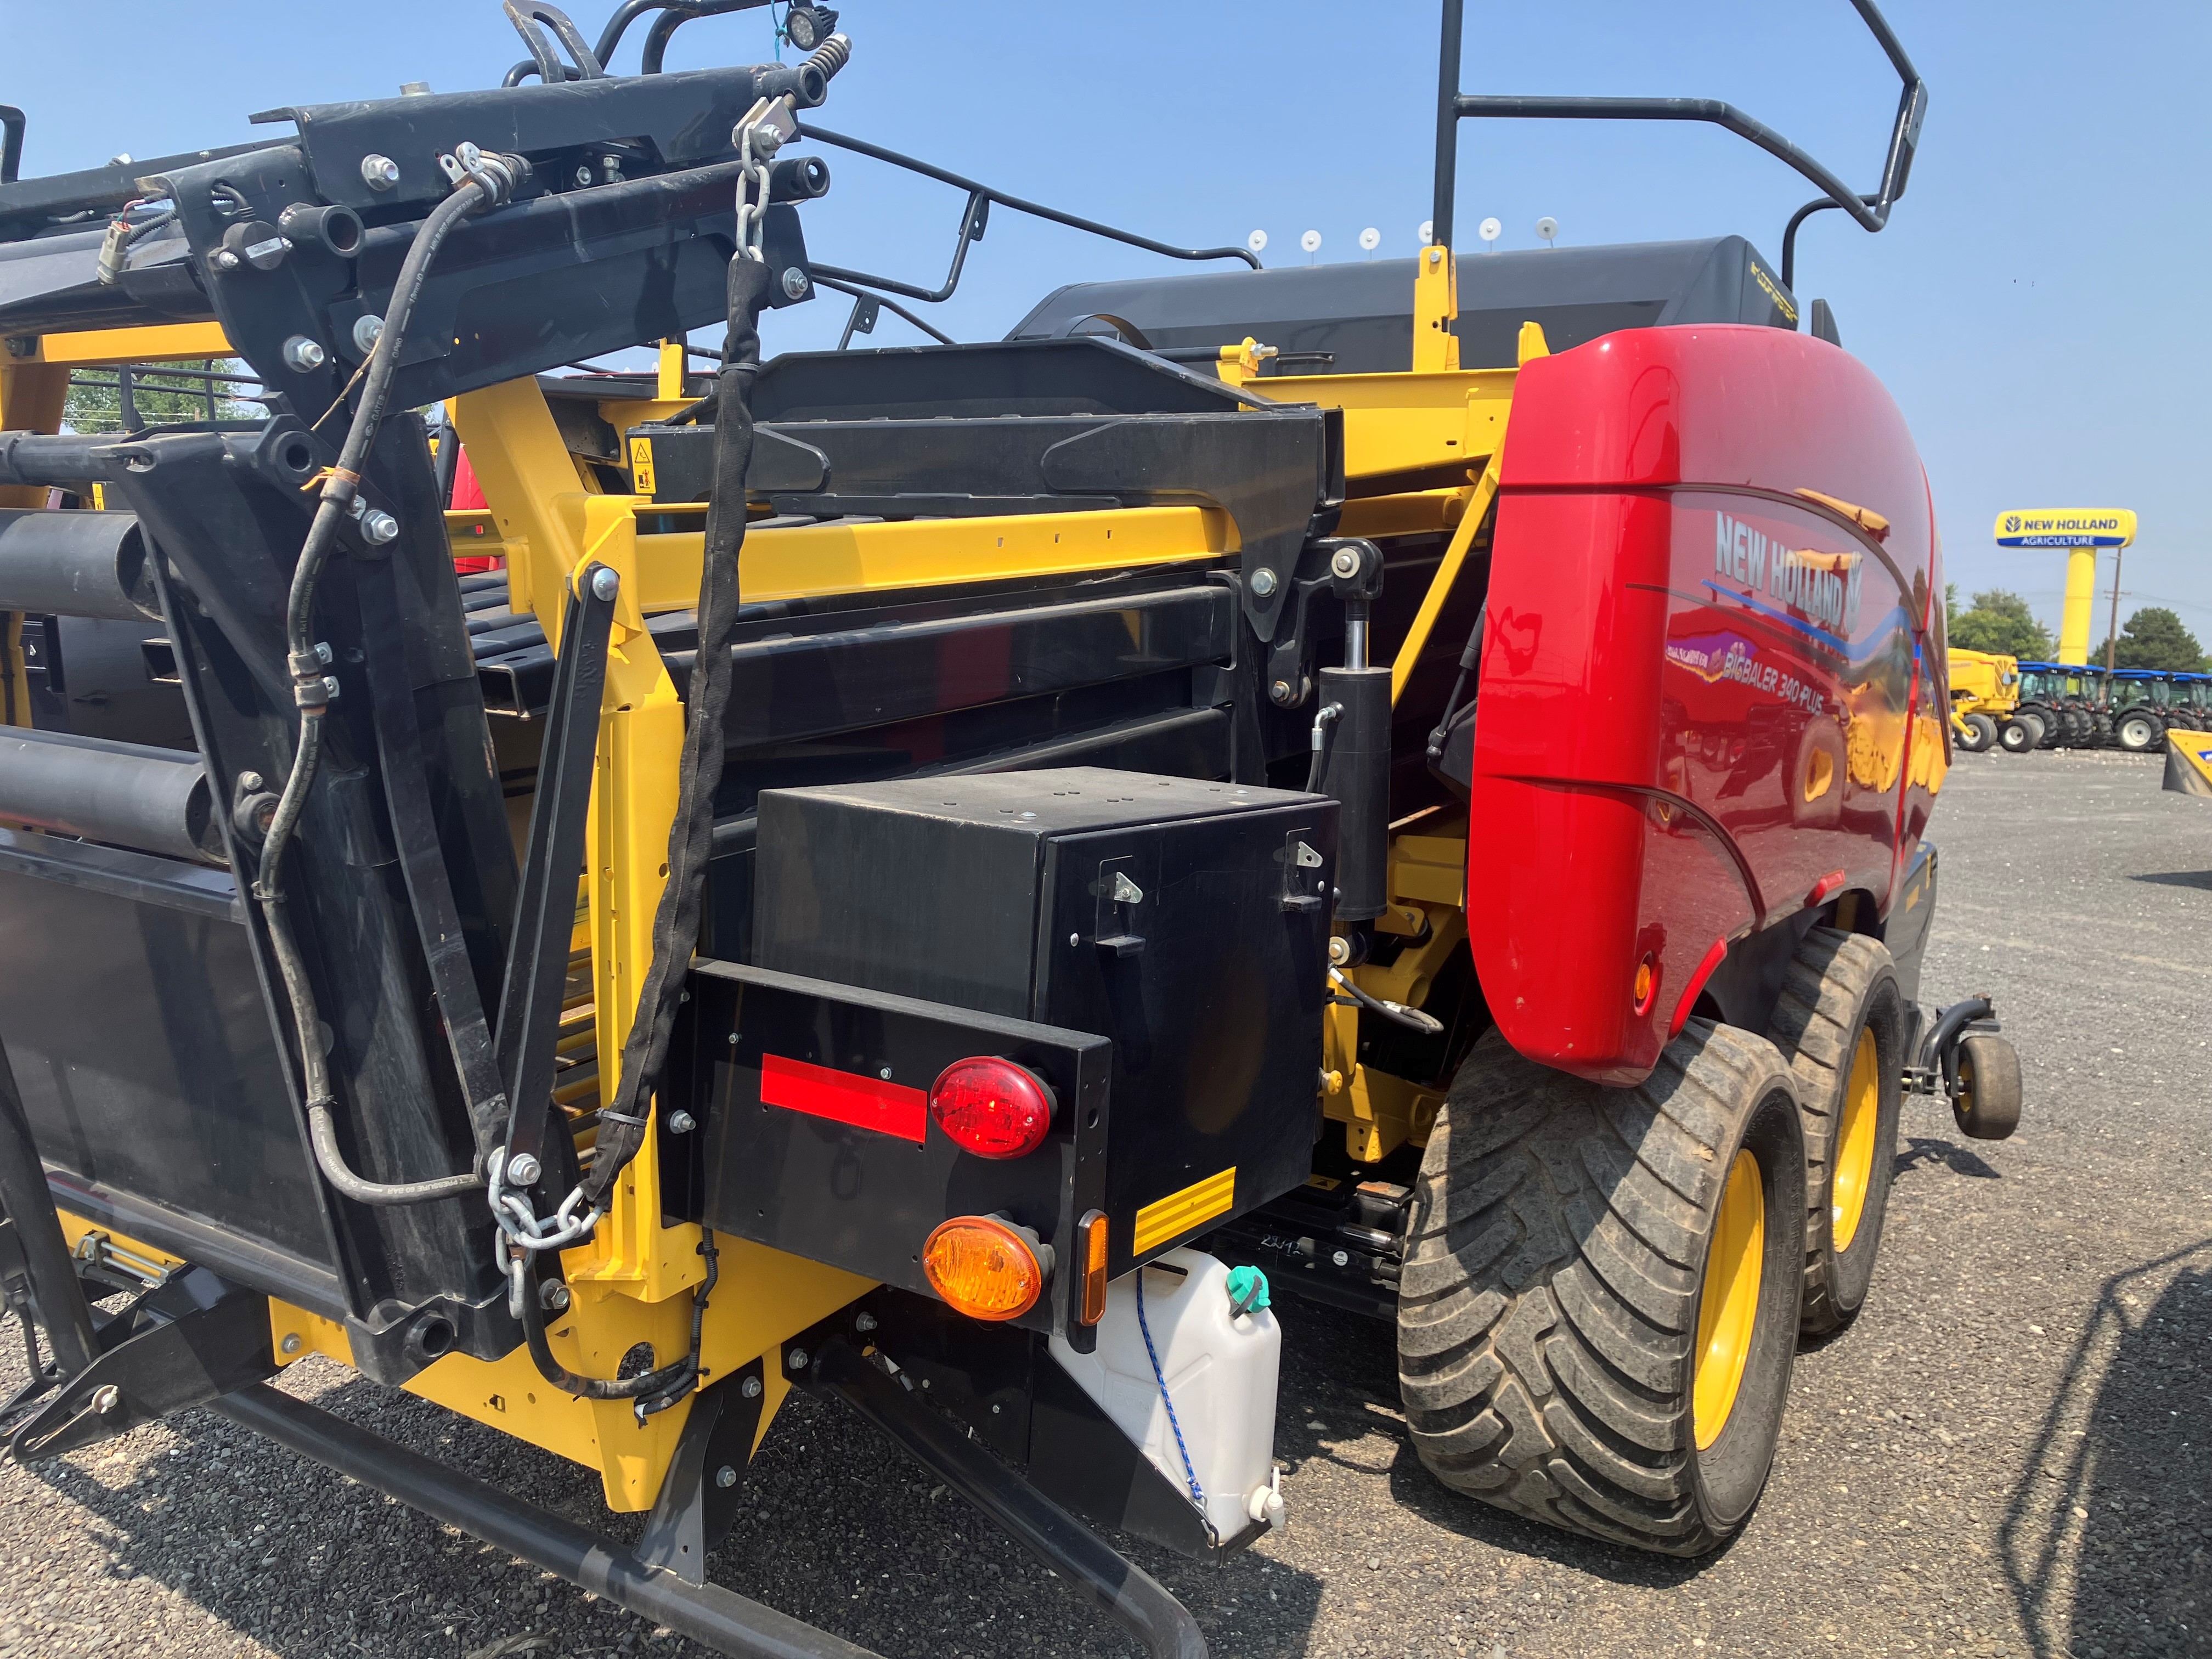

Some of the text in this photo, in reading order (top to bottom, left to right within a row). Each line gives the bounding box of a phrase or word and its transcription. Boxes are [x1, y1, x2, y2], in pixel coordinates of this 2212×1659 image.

[371, 394, 385, 421] GATES
[2024, 518, 2119, 531] NEW HOLLAND
[2021, 535, 2095, 546] AGRICULTURE
[1716, 510, 1843, 627] NEW HOLLAND
[1722, 652, 1779, 694] BIGBALER
[1777, 673, 1800, 703] 340
[1799, 685, 1825, 716] PLUS
[325, 1156, 358, 1188] OIL RESISTANT
[416, 1179, 459, 1192] PRESSURE
